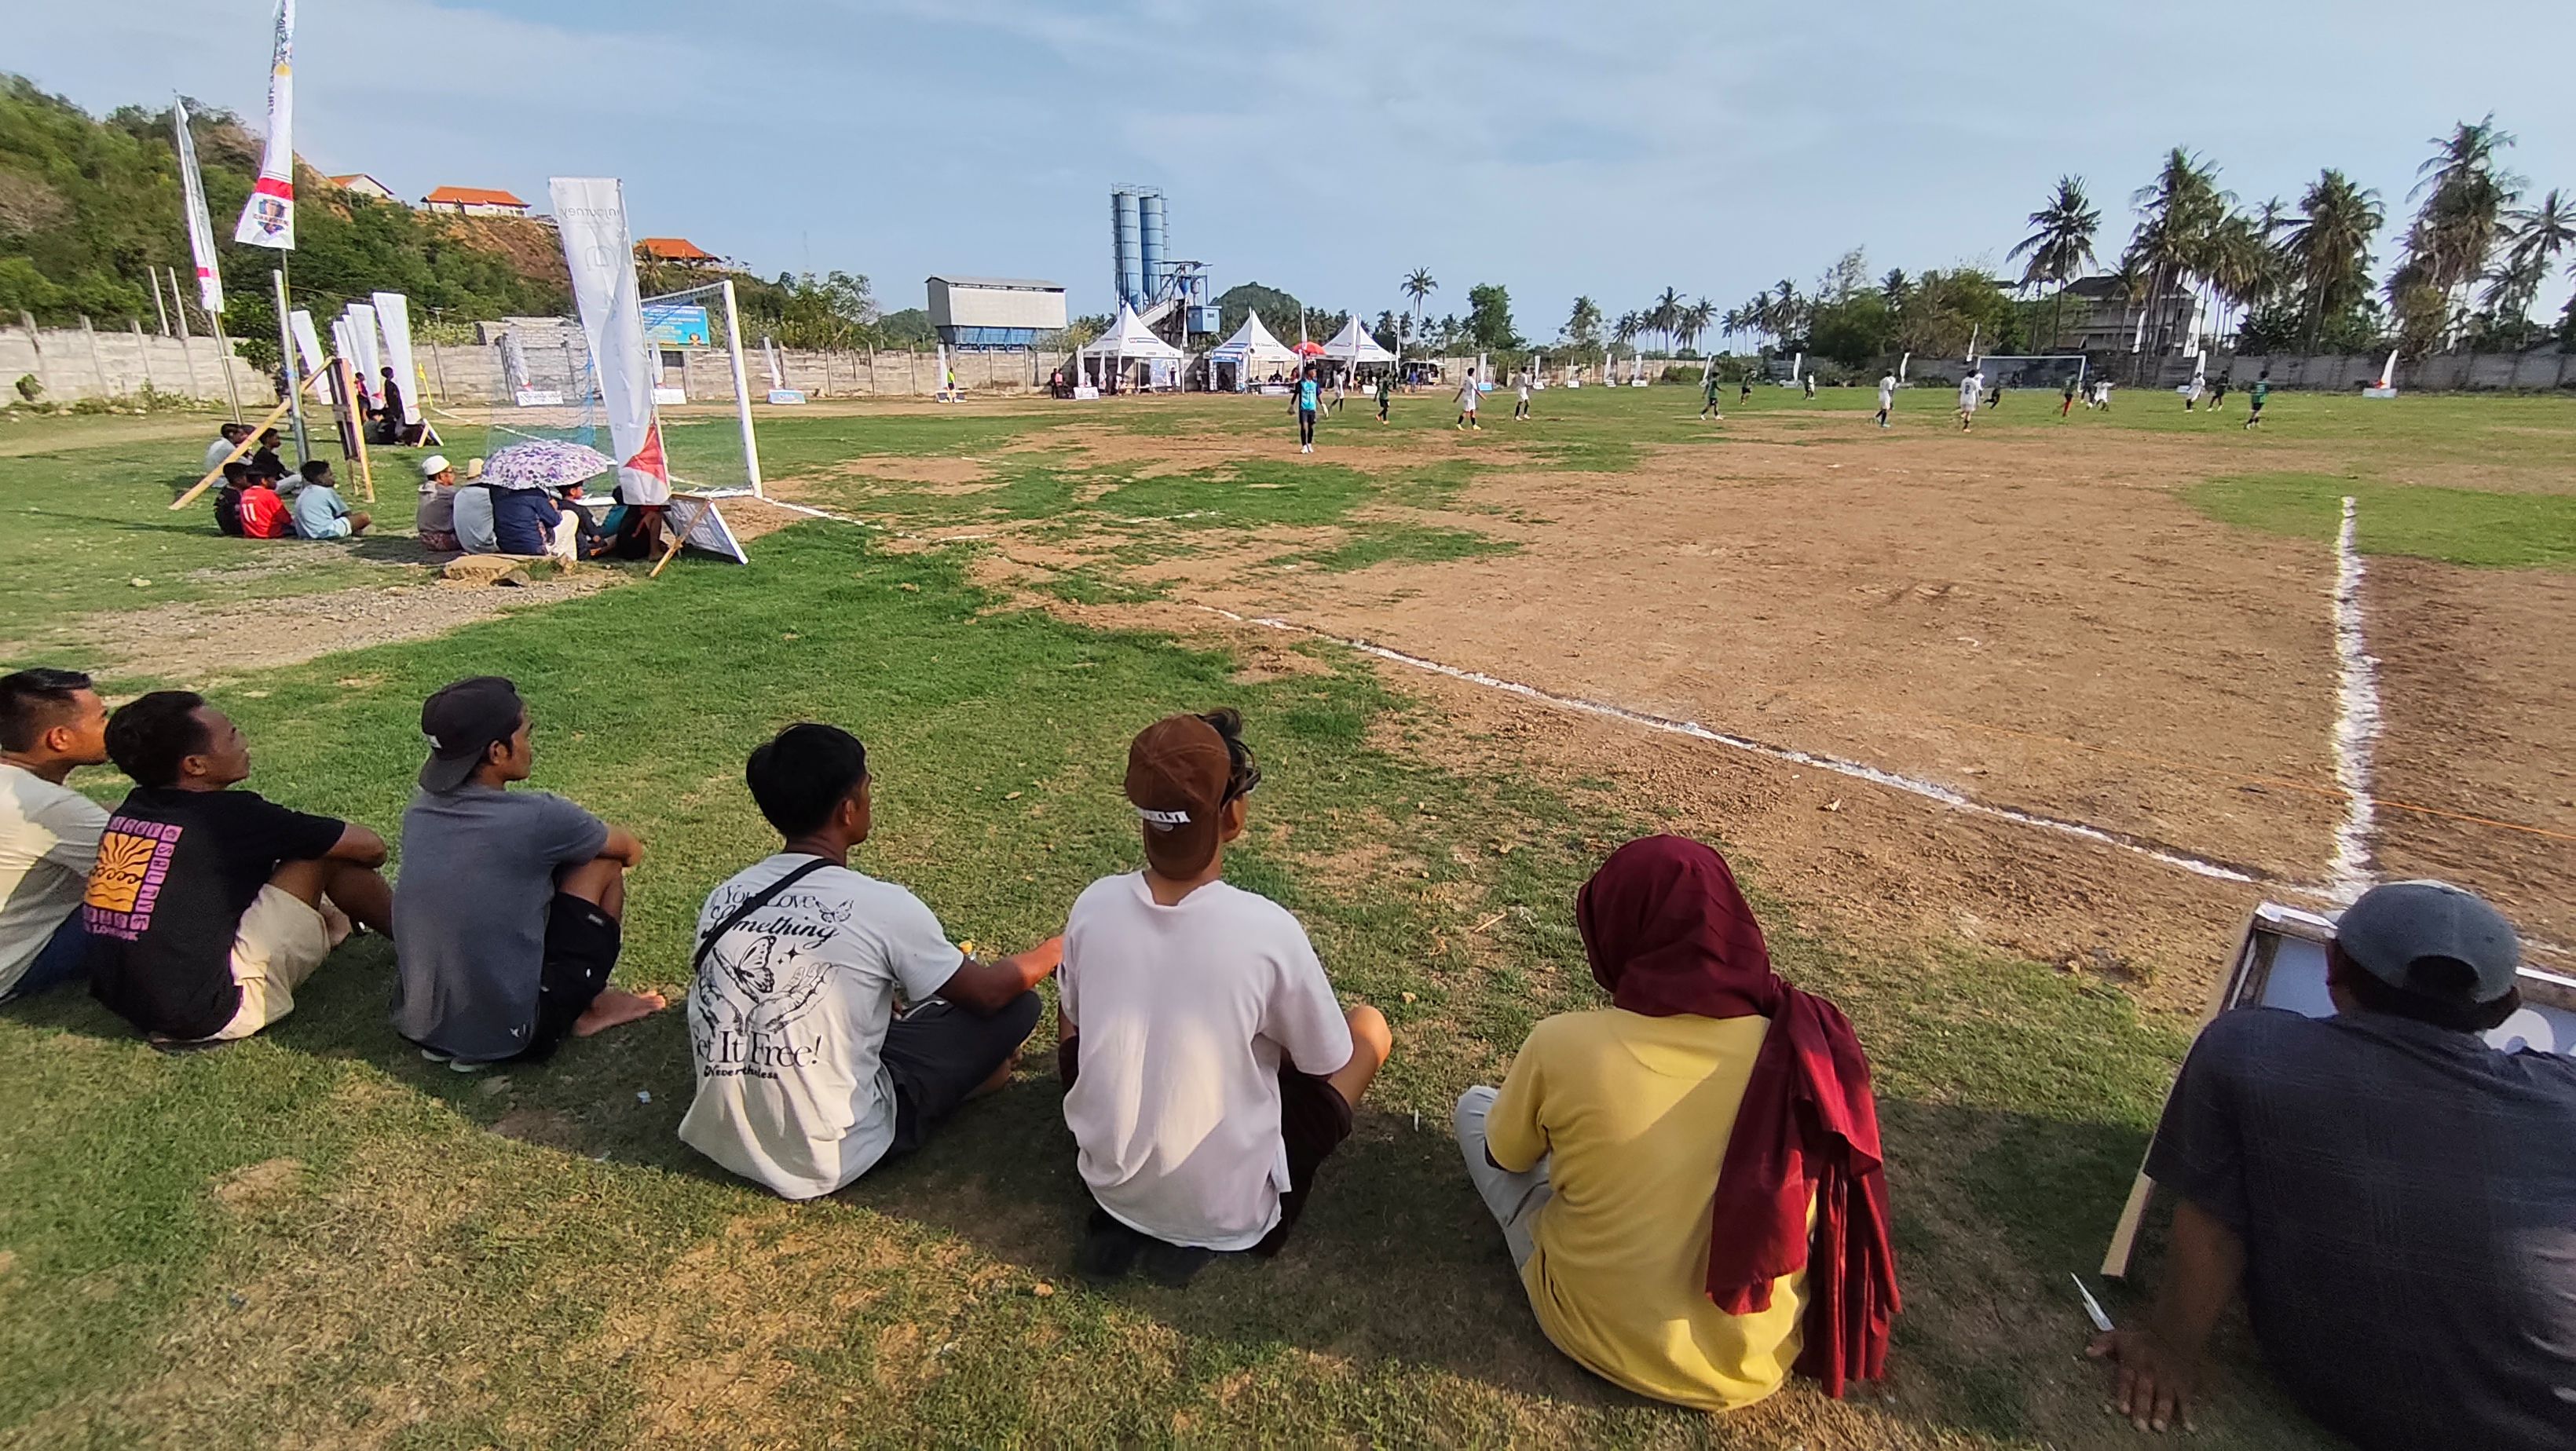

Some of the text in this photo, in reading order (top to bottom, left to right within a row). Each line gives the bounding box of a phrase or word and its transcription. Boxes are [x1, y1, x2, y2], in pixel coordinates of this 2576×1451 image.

[242, 503, 257, 522] 11
[701, 905, 840, 949] Smething
[719, 1031, 745, 1062] It
[751, 1031, 822, 1068] Free!
